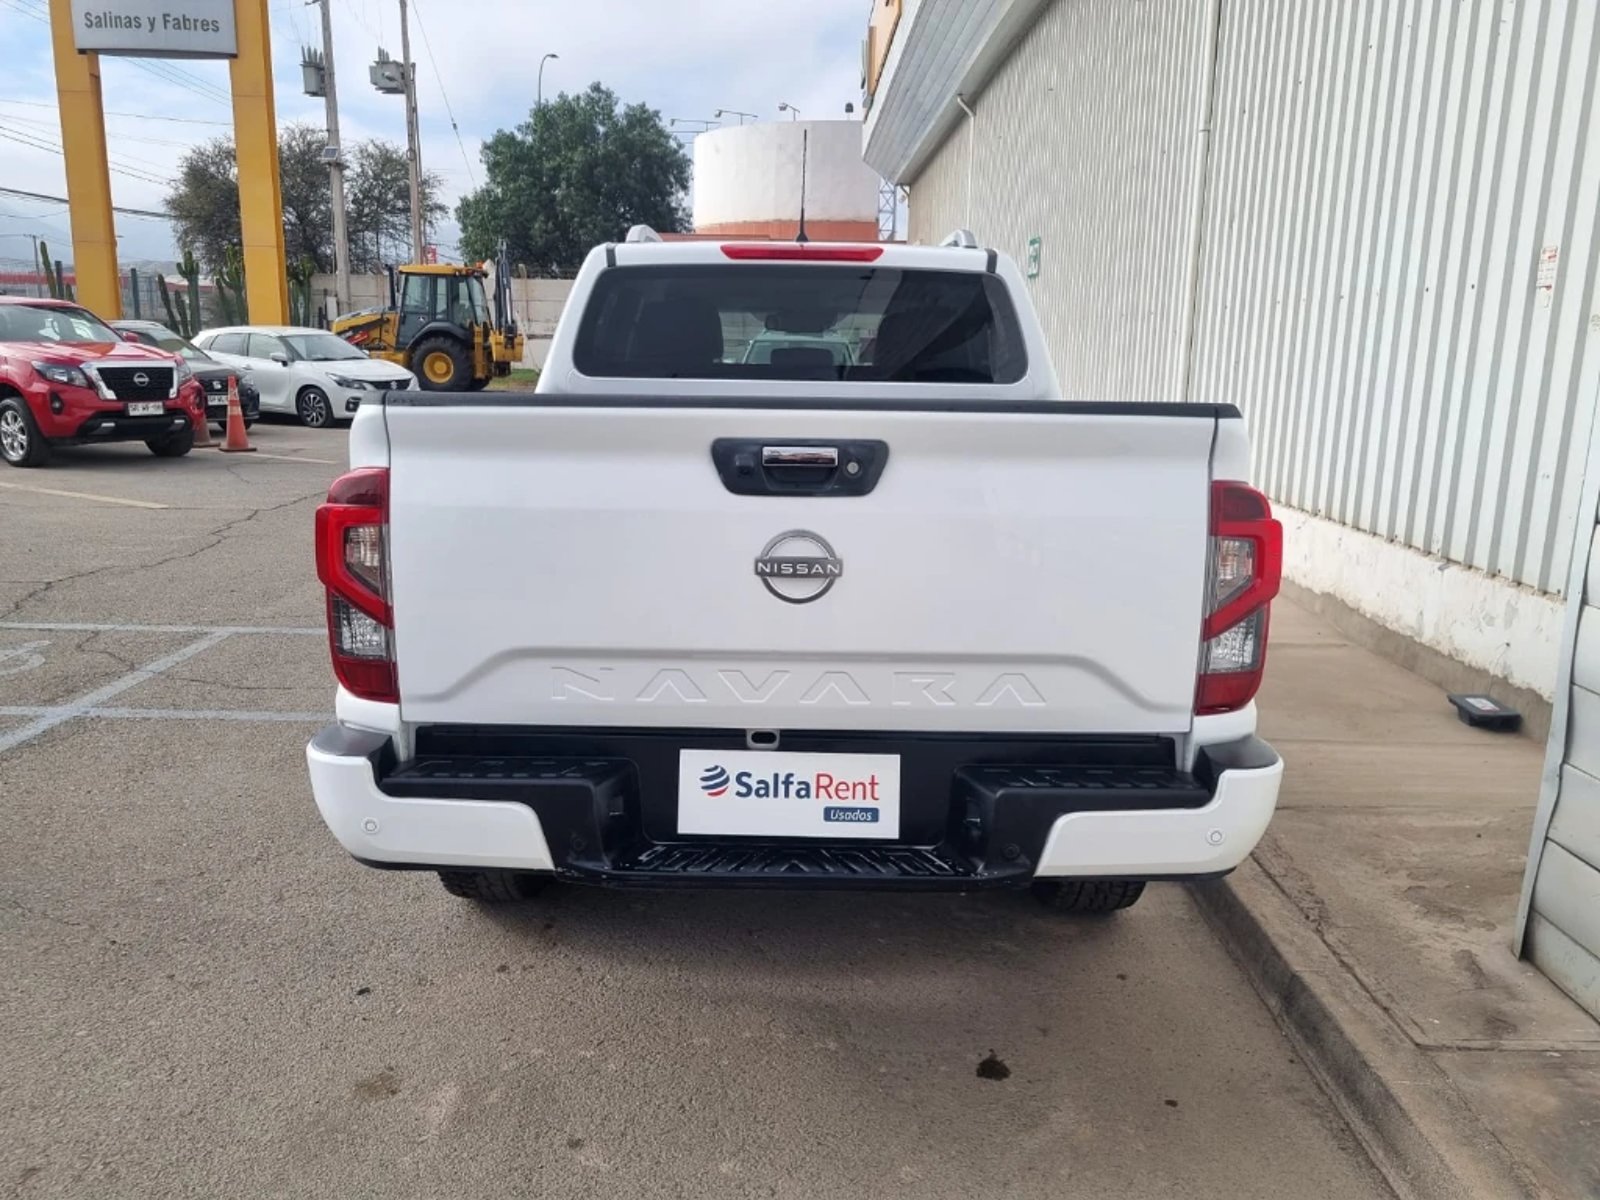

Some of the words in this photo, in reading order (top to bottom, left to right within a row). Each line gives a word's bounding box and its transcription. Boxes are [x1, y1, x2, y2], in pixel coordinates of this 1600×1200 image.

[84, 11, 142, 29] Salinas
[147, 16, 156, 33] y
[162, 13, 220, 33] Fabres
[757, 561, 840, 575] NISSAN
[551, 666, 1047, 706] NAVARA
[735, 771, 880, 801] SalfaRent
[830, 808, 872, 822] Usados
